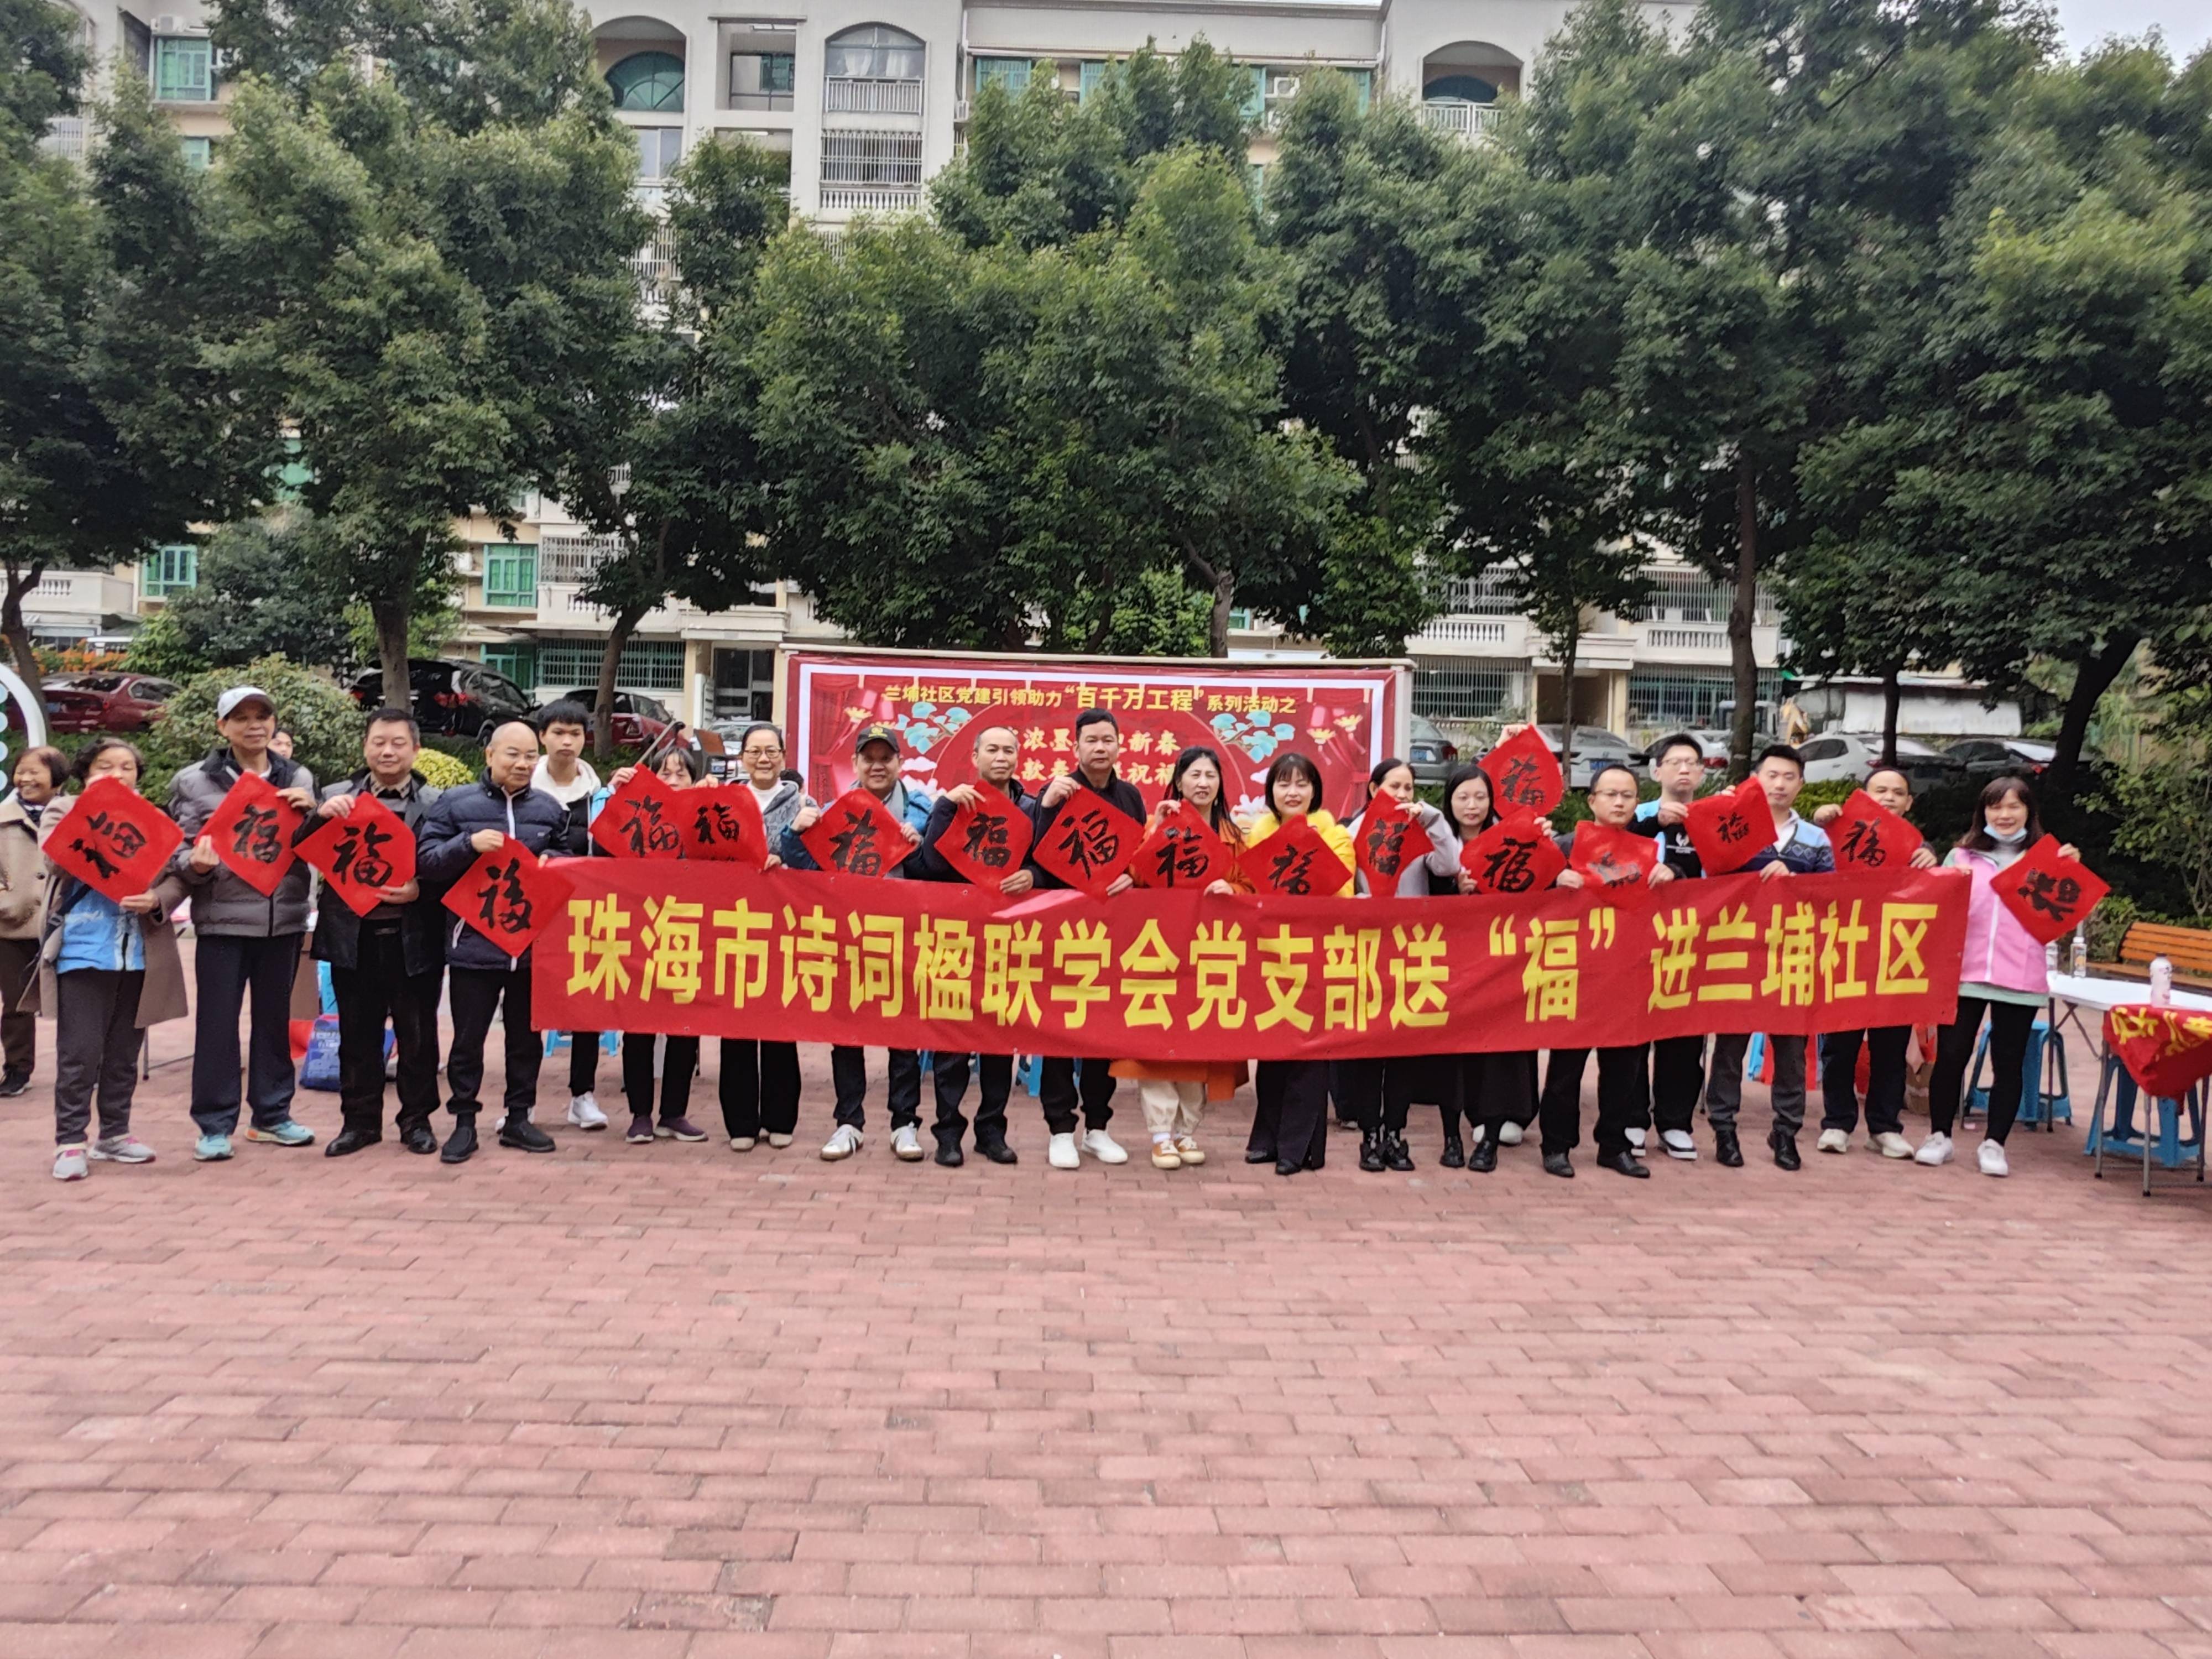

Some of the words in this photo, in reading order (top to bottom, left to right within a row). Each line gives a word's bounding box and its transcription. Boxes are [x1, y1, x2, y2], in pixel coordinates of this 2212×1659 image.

[1501, 754, 1543, 805] 福
[233, 804, 282, 864] 福
[619, 795, 679, 857] 福
[693, 802, 739, 844] 福
[828, 809, 881, 876] 福
[962, 811, 1011, 868] 福
[1058, 809, 1119, 880] 福
[1717, 812, 1749, 843] 福
[333, 822, 393, 888] 福
[1155, 826, 1209, 887] 福
[1483, 837, 1538, 893] 福
[477, 857, 531, 933] 福
[566, 892, 1938, 1033] 珠海市诗词楹联学会党支部送“福”进兰埔社区
